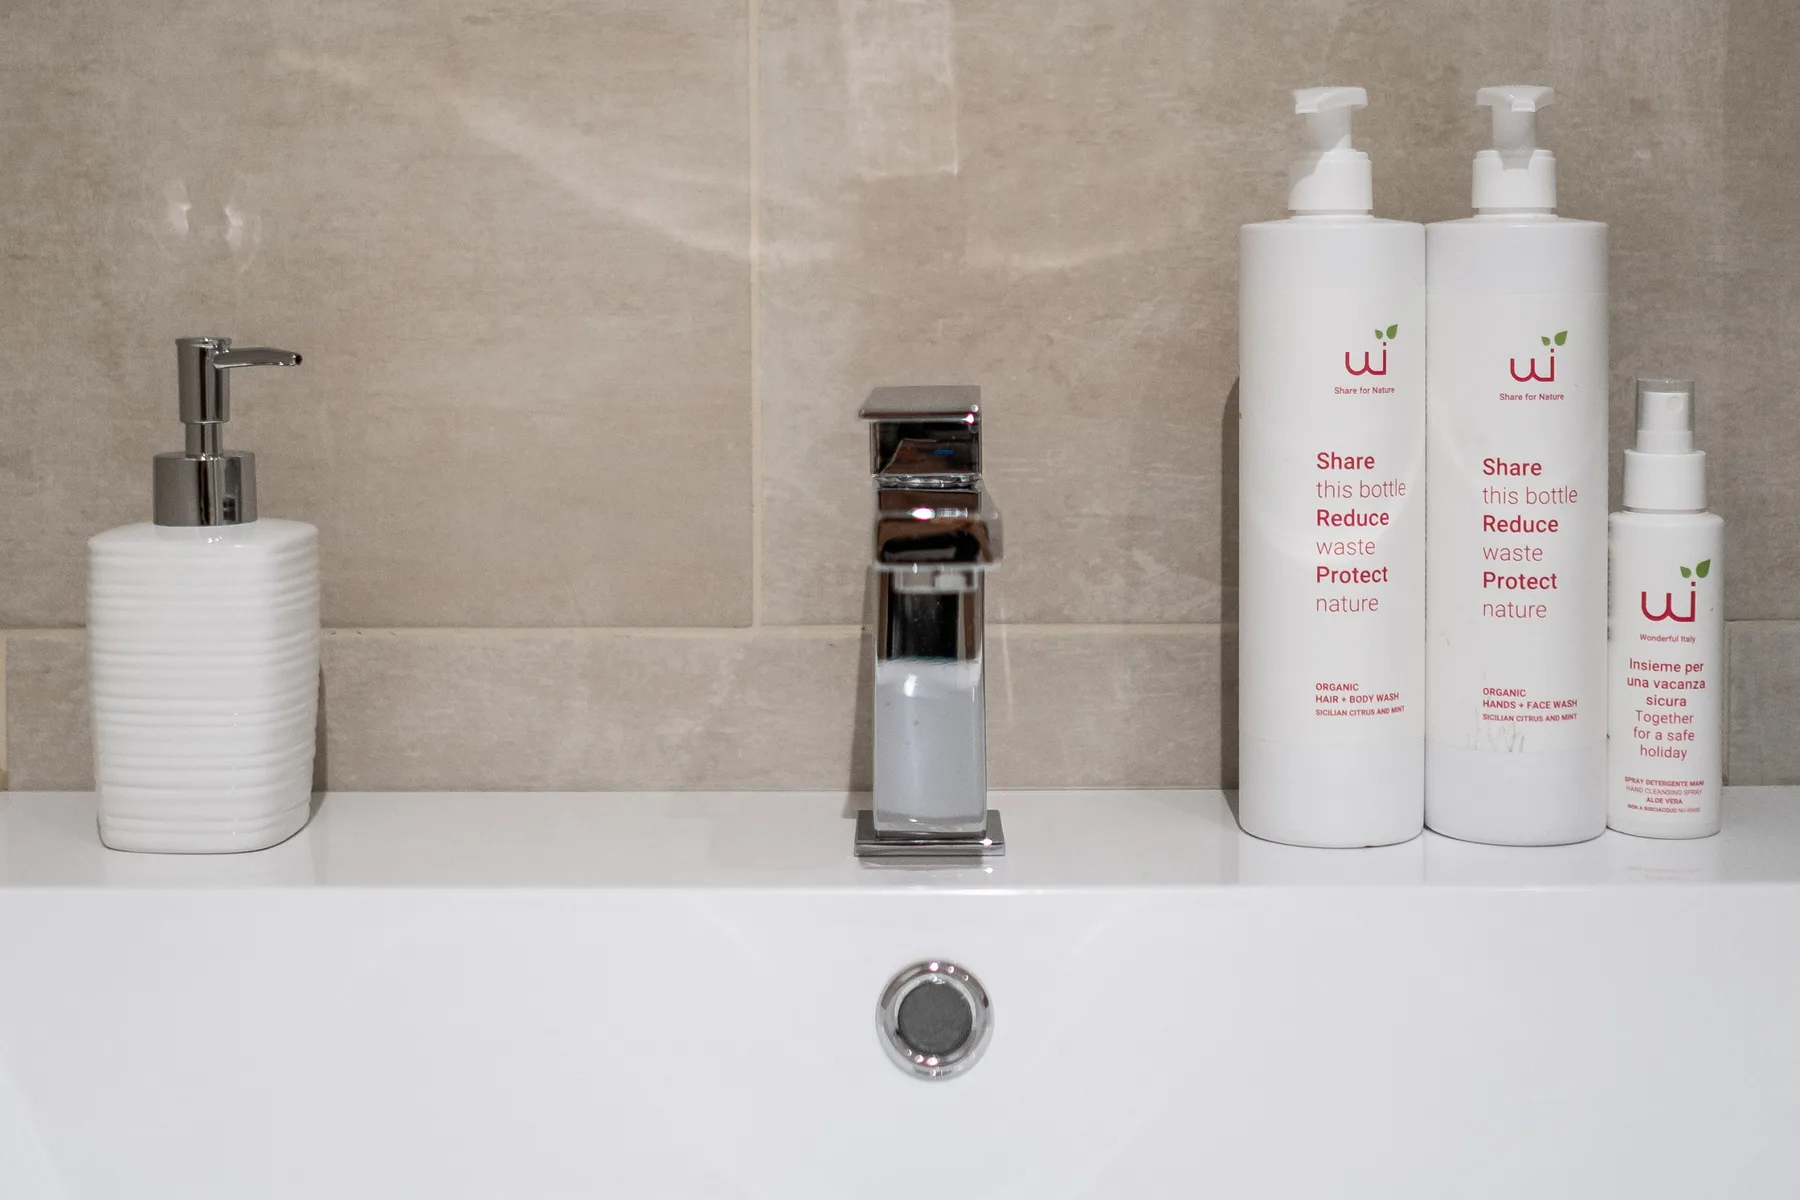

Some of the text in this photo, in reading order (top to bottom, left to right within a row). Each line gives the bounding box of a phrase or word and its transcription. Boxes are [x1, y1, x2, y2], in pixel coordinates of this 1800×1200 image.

[1334, 385, 1396, 395] Share for Nature
[1499, 392, 1565, 402] Share for Nature
[1316, 451, 1376, 471] Share
[1482, 457, 1543, 477] Share
[1316, 478, 1407, 499] this bottle
[1482, 485, 1579, 505] this bottle
[1316, 509, 1390, 527] Reduce
[1482, 514, 1559, 533] Reduce
[1316, 538, 1376, 556] waste
[1482, 544, 1544, 562] waste
[1316, 565, 1389, 584] Protect
[1482, 571, 1558, 590] Protect
[1316, 596, 1379, 613] nature
[1482, 601, 1548, 619] nature
[1639, 633, 1696, 644] Wonderful Italy
[1629, 657, 1704, 676] Insieme per
[1315, 682, 1360, 692] ORGANIC
[1626, 676, 1706, 690] una vacanza
[1315, 695, 1339, 704] HAIR
[1349, 694, 1374, 704] BODY
[1376, 692, 1400, 703] WASH
[1482, 687, 1527, 697] ORGANIC
[1482, 699, 1516, 709] HANDS
[1527, 700, 1551, 709] FACE
[1553, 699, 1578, 709] WASH
[1646, 694, 1687, 707] sicura
[1315, 709, 1348, 717] SICILIAN
[1349, 708, 1375, 717] CITRUS
[1391, 705, 1405, 714] MINT
[1482, 713, 1514, 722] SICILIAN
[1545, 714, 1560, 722] AND
[1561, 713, 1577, 721] MINT
[1635, 709, 1694, 727] Together
[1633, 726, 1695, 742] for a safe
[1639, 744, 1688, 762] holiday
[1624, 776, 1644, 784] SPRAY
[1645, 779, 1688, 787] DETERGENTE
[1626, 785, 1644, 793] HAND
[1644, 788, 1683, 796] CLEANSING
[1646, 796, 1663, 804] ALOE
